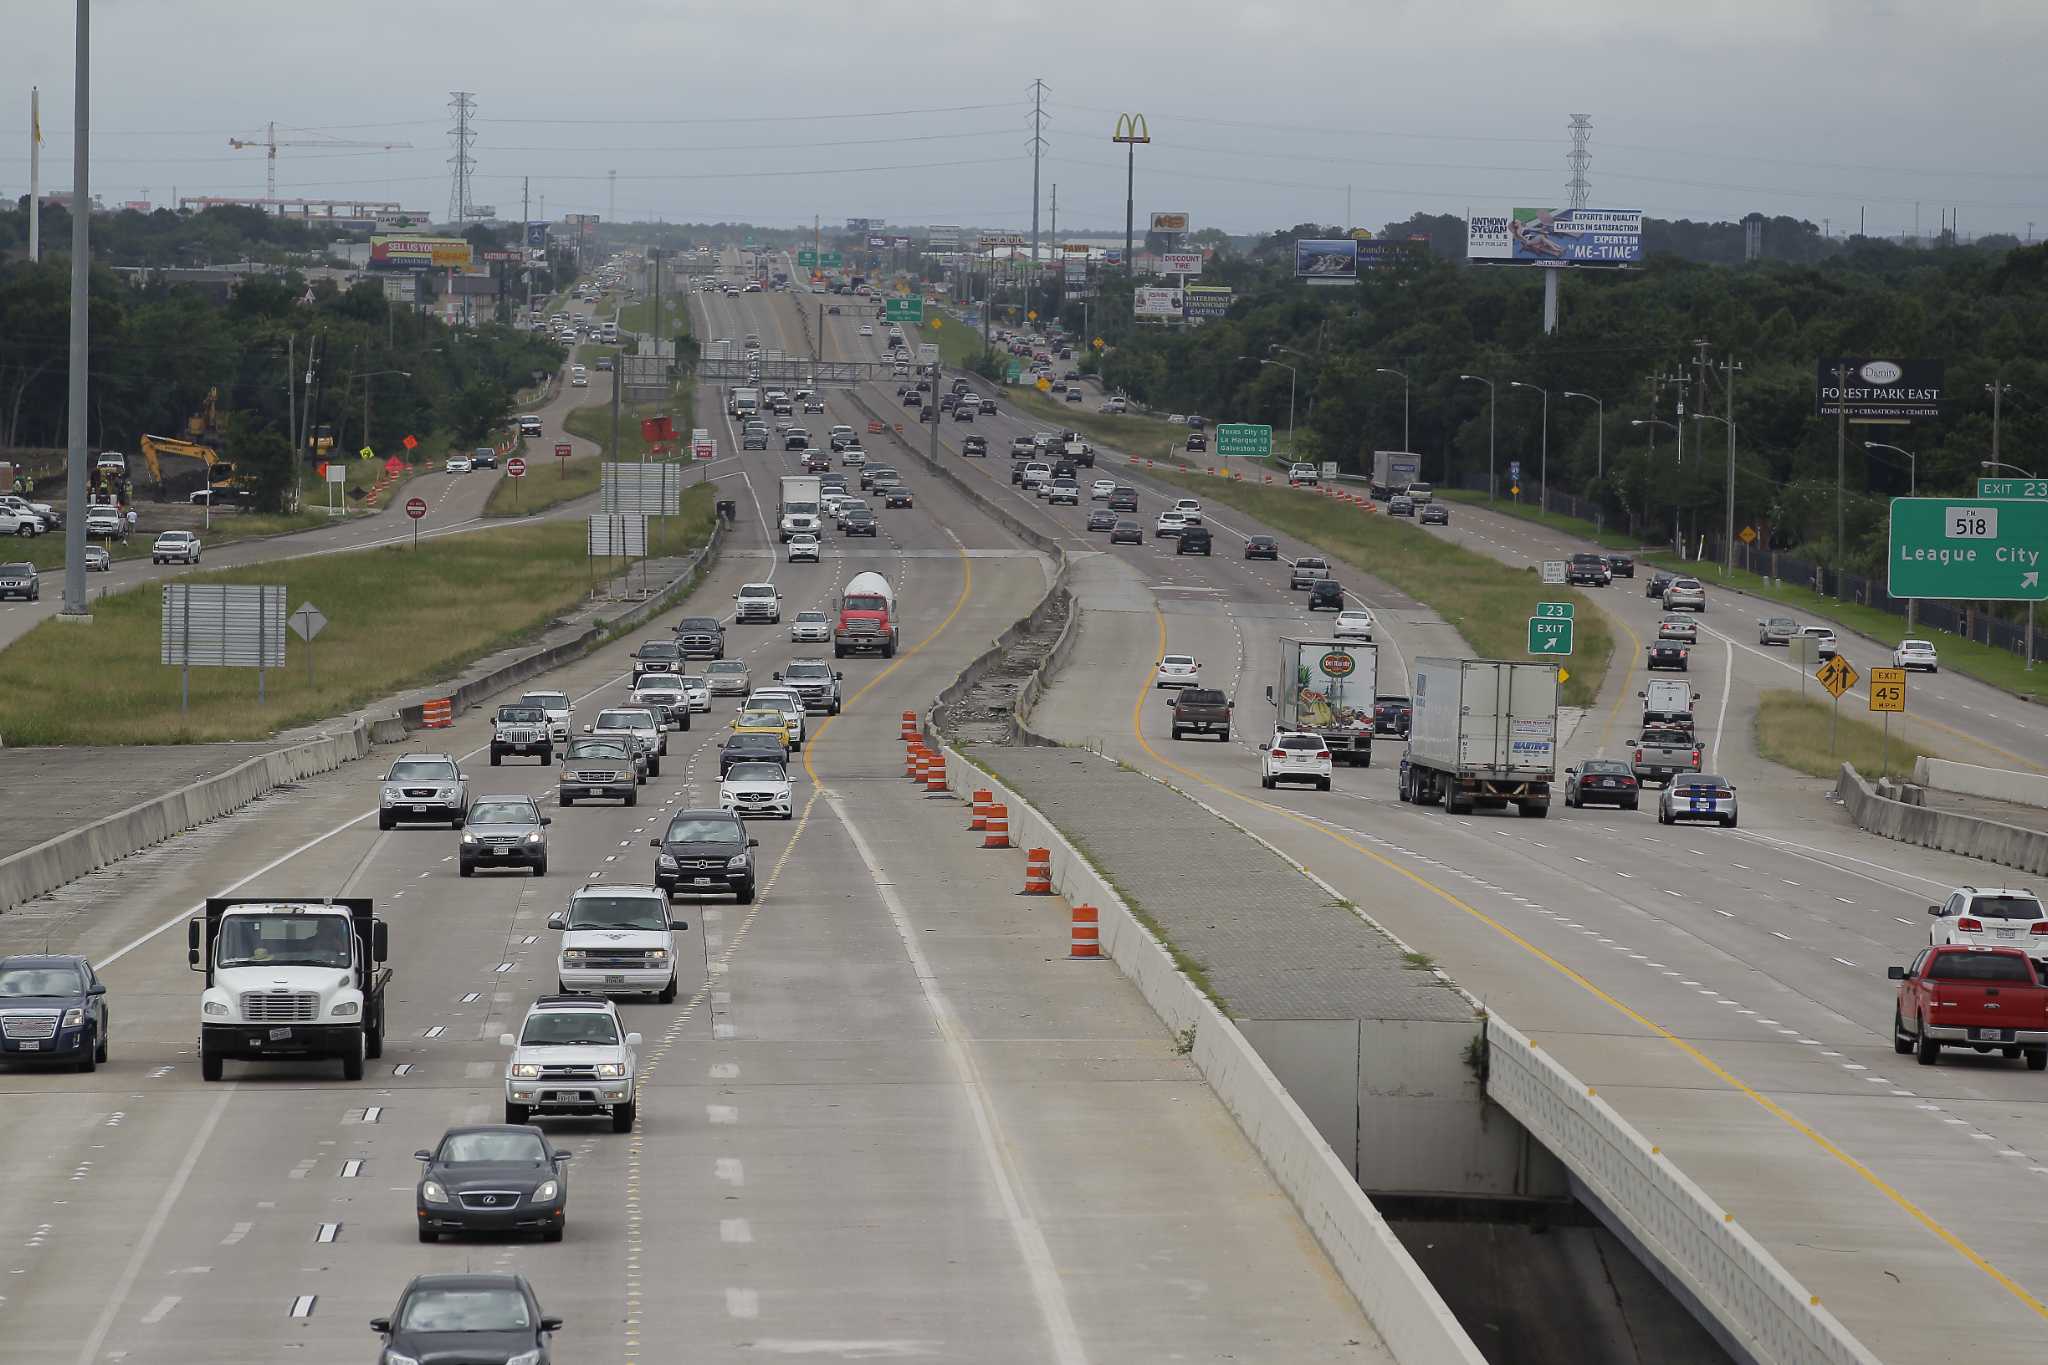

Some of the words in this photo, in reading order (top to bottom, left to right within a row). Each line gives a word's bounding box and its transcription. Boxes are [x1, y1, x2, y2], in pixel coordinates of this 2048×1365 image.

[1472, 217, 1507, 225] ANTHONY
[1594, 236, 1628, 244] EXPERTS
[1630, 236, 1638, 244] IN
[1873, 389, 1905, 399] PARK
[1908, 389, 1939, 400] EAST
[1984, 484, 2012, 494] EXIT
[2023, 482, 2048, 497] 23
[1956, 518, 1987, 535] 518
[1902, 545, 1977, 566] League
[1995, 545, 2039, 566] City
[1546, 606, 1563, 616] 23
[1537, 624, 1564, 633] EXIT
[1878, 672, 1897, 680] EXIT
[1876, 687, 1900, 701] 45
